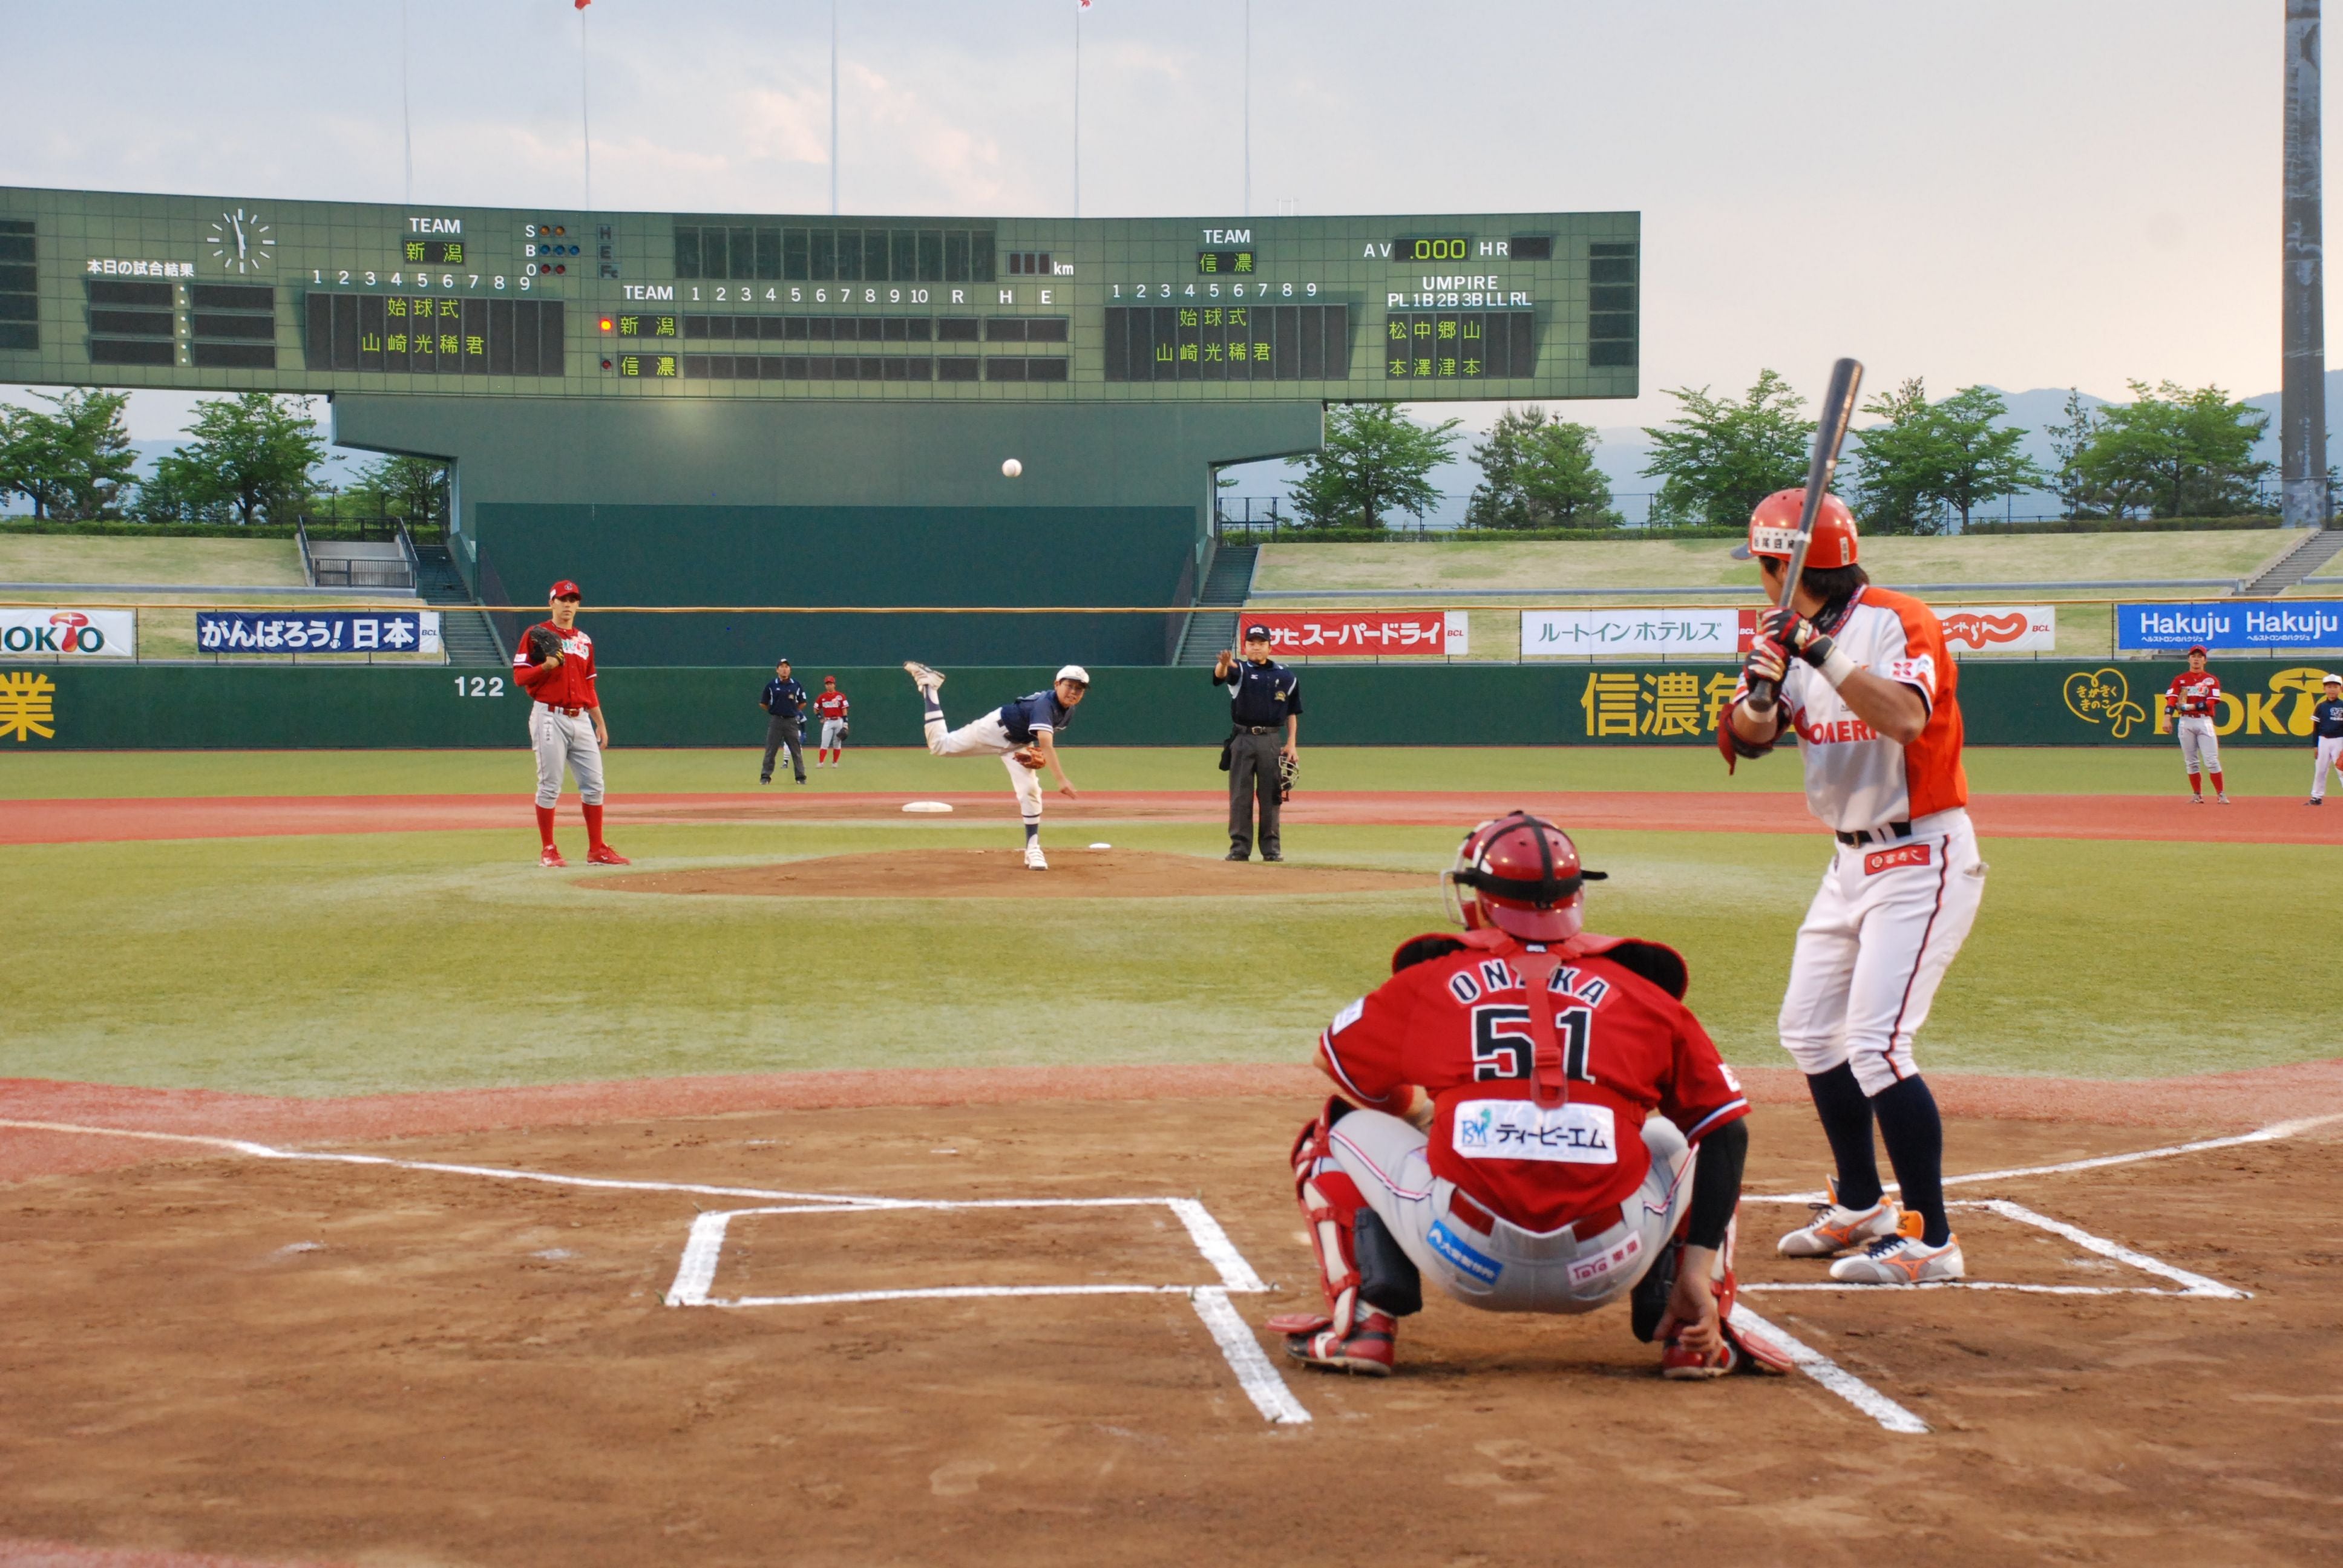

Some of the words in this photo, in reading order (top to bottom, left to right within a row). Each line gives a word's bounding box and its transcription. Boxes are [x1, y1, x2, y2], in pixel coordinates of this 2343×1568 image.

[410, 218, 460, 233] TEAM
[526, 225, 535, 237] S
[1204, 230, 1250, 243] TEAM
[526, 245, 535, 256] B
[1364, 244, 1391, 257] AV
[1480, 242, 1507, 255] HR
[88, 260, 194, 277] 本日の試合結果
[1054, 261, 1073, 275] km
[313, 270, 321, 283] 1
[339, 270, 349, 284] 2
[365, 272, 375, 285] 3
[391, 273, 402, 286] 4
[418, 273, 427, 287] 5
[443, 274, 453, 287] 6
[469, 275, 478, 288] 7
[494, 276, 504, 289] 8
[520, 277, 530, 291] 9
[1423, 276, 1498, 290] UMPIRE
[624, 286, 672, 299] TEAM
[693, 287, 700, 300] 1
[716, 287, 726, 301] 2
[741, 287, 751, 301] 3
[766, 288, 776, 301] 4
[791, 288, 801, 301] 5
[816, 289, 826, 302] 6
[841, 289, 850, 302] 7
[865, 289, 876, 302] 8
[890, 289, 899, 302] 9
[911, 289, 928, 302] 10
[952, 290, 963, 303] R
[1000, 290, 1012, 304] H
[1041, 290, 1052, 304] E
[1113, 284, 1119, 297] 1
[1137, 284, 1145, 297] 2
[1161, 284, 1170, 297] 3
[1185, 284, 1194, 296] 4
[1210, 284, 1219, 296] 5
[1234, 284, 1243, 296] 6
[1259, 284, 1267, 296] 7
[1283, 283, 1292, 296] 8
[1307, 283, 1316, 296] 9
[1388, 293, 1409, 307] PL
[1414, 293, 1434, 306] 1B
[1437, 293, 1458, 306] 2B
[1463, 293, 1483, 306] 3B
[1487, 292, 1507, 305] LL
[1510, 292, 1532, 305] RL
[387, 298, 459, 319] 始球式
[1180, 309, 1247, 327] 始球式
[2141, 612, 2230, 640] Hakuju
[2246, 610, 2338, 639] Hakuju
[455, 677, 503, 696] 122
[1449, 959, 1610, 1008] ONKA
[1471, 1004, 1596, 1085] 51
